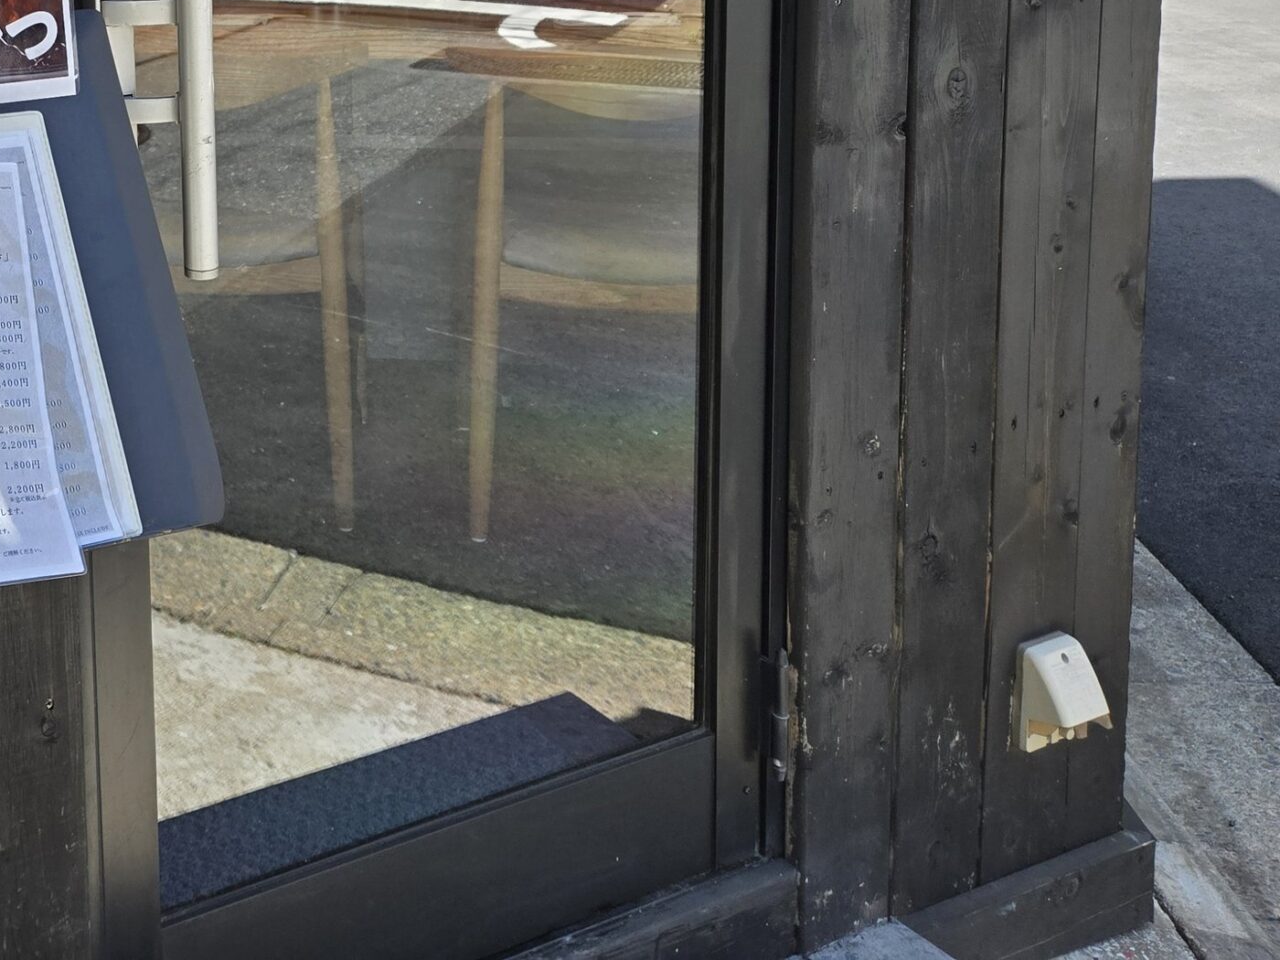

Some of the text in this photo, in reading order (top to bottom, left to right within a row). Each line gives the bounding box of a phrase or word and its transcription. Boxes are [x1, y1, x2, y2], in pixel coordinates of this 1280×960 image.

[0, 424, 35, 435] 2,800円
[1, 439, 38, 450] 2,200円
[4, 460, 41, 471] 1,800円
[7, 483, 44, 495] 2,200円
